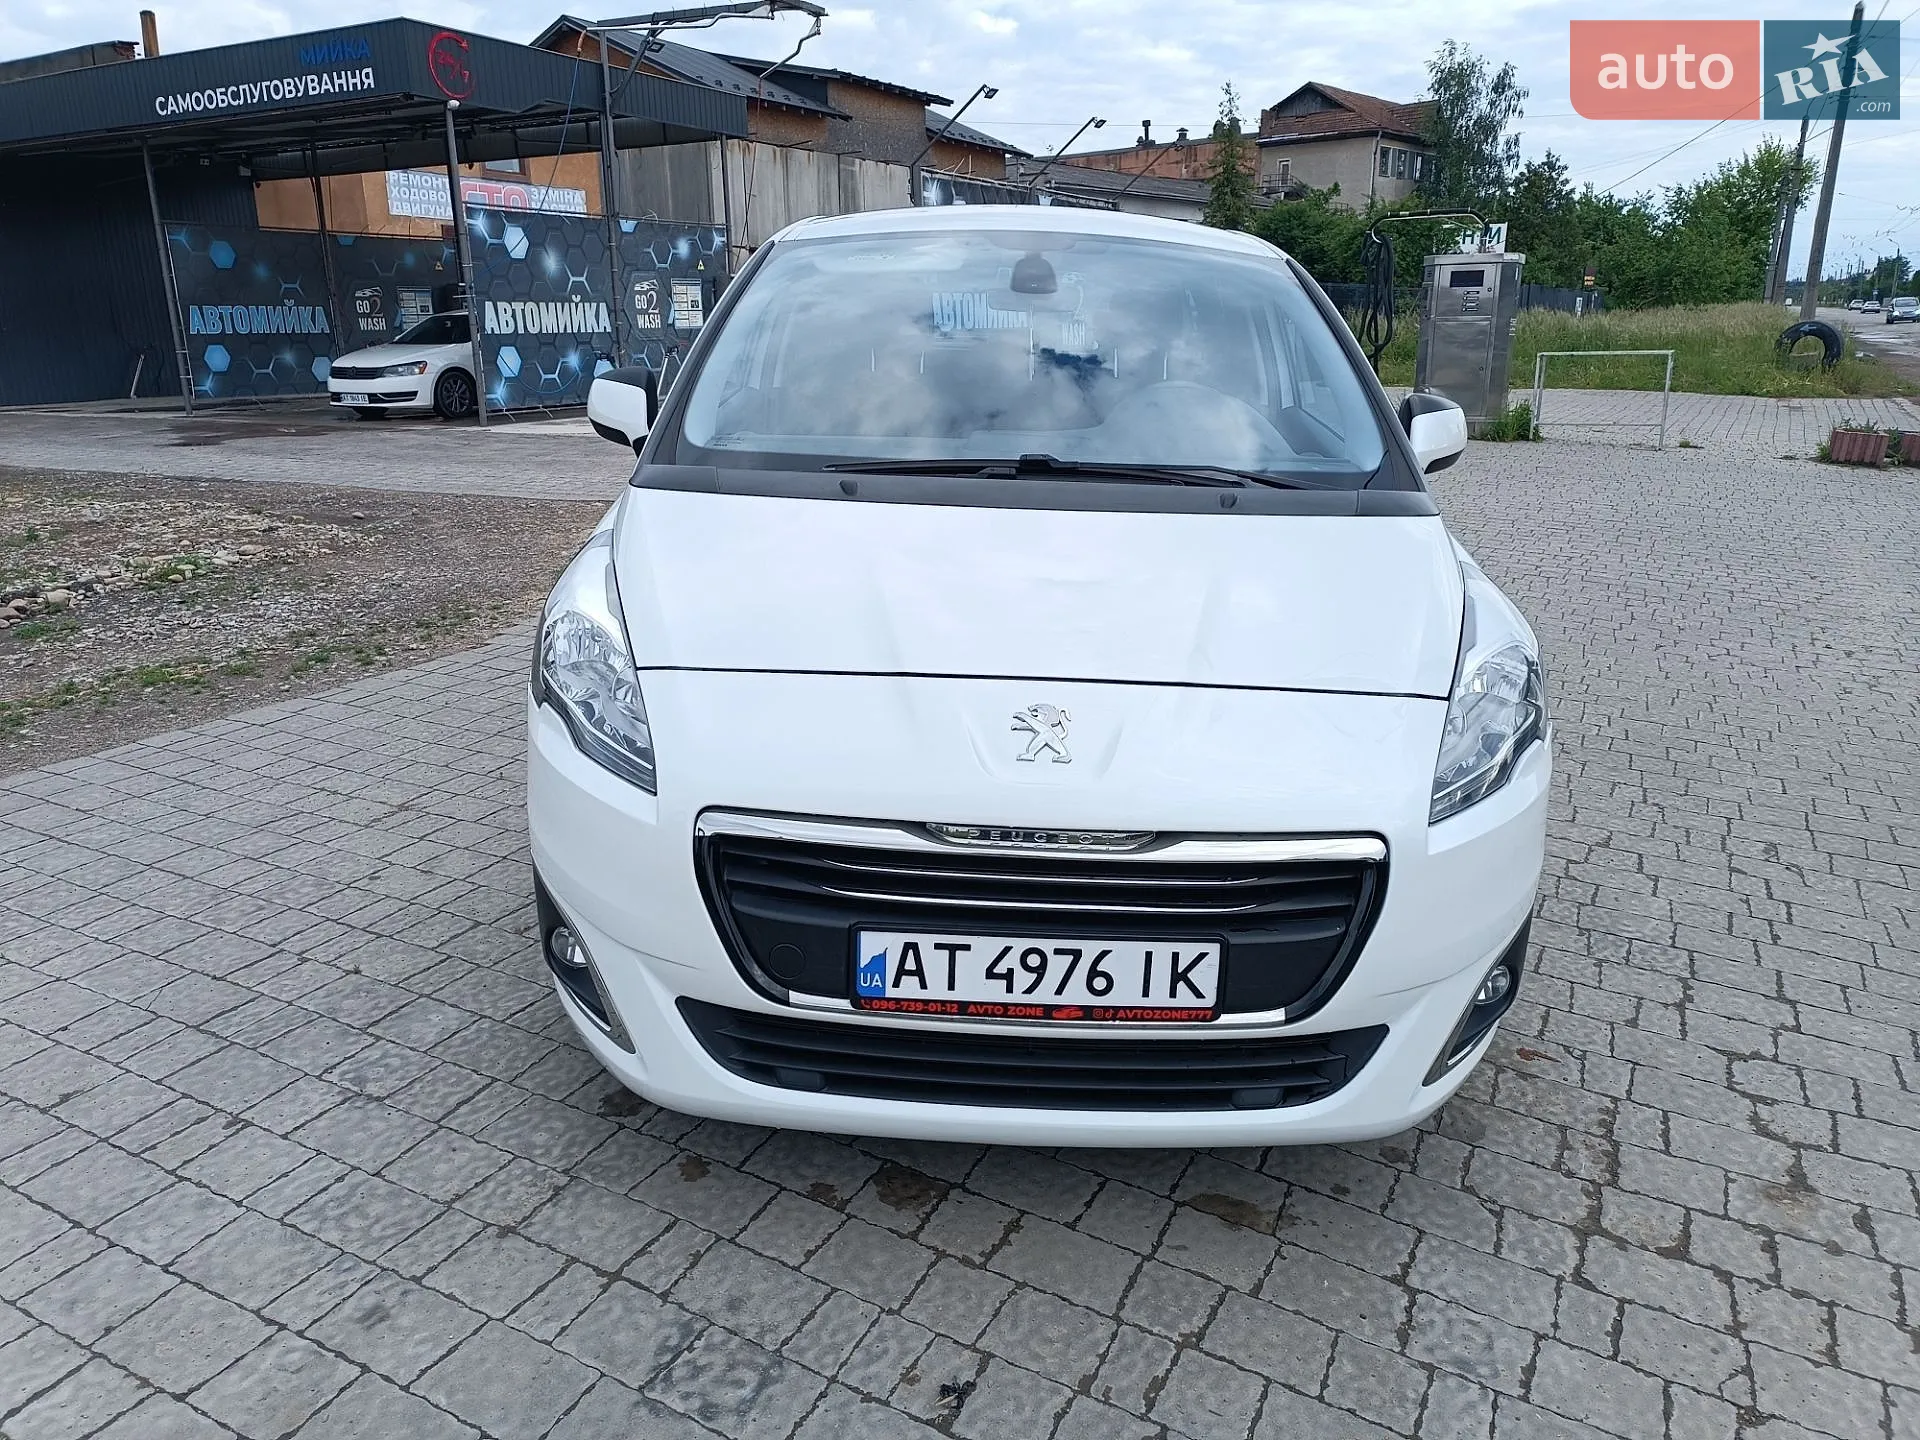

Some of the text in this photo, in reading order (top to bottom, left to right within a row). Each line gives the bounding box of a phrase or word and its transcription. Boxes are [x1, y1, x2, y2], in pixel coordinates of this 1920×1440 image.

[300, 37, 371, 66] МИЙКА
[155, 67, 375, 116] САМООБСЛУГОВУВАННЯ
[356, 300, 370, 313] GO
[371, 297, 383, 317] 2
[635, 291, 660, 314] GO 2
[189, 299, 330, 335] АВТОМИЙКА
[358, 317, 387, 331] WASH
[484, 295, 612, 334] АВТОМИЙКА
[637, 314, 661, 329] WASH
[860, 972, 883, 988] UA
[891, 941, 1211, 999] AT 4976 IK
[871, 1000, 1213, 1020] 096-739-01-12 AVTO ZONE AVTOZONE777
